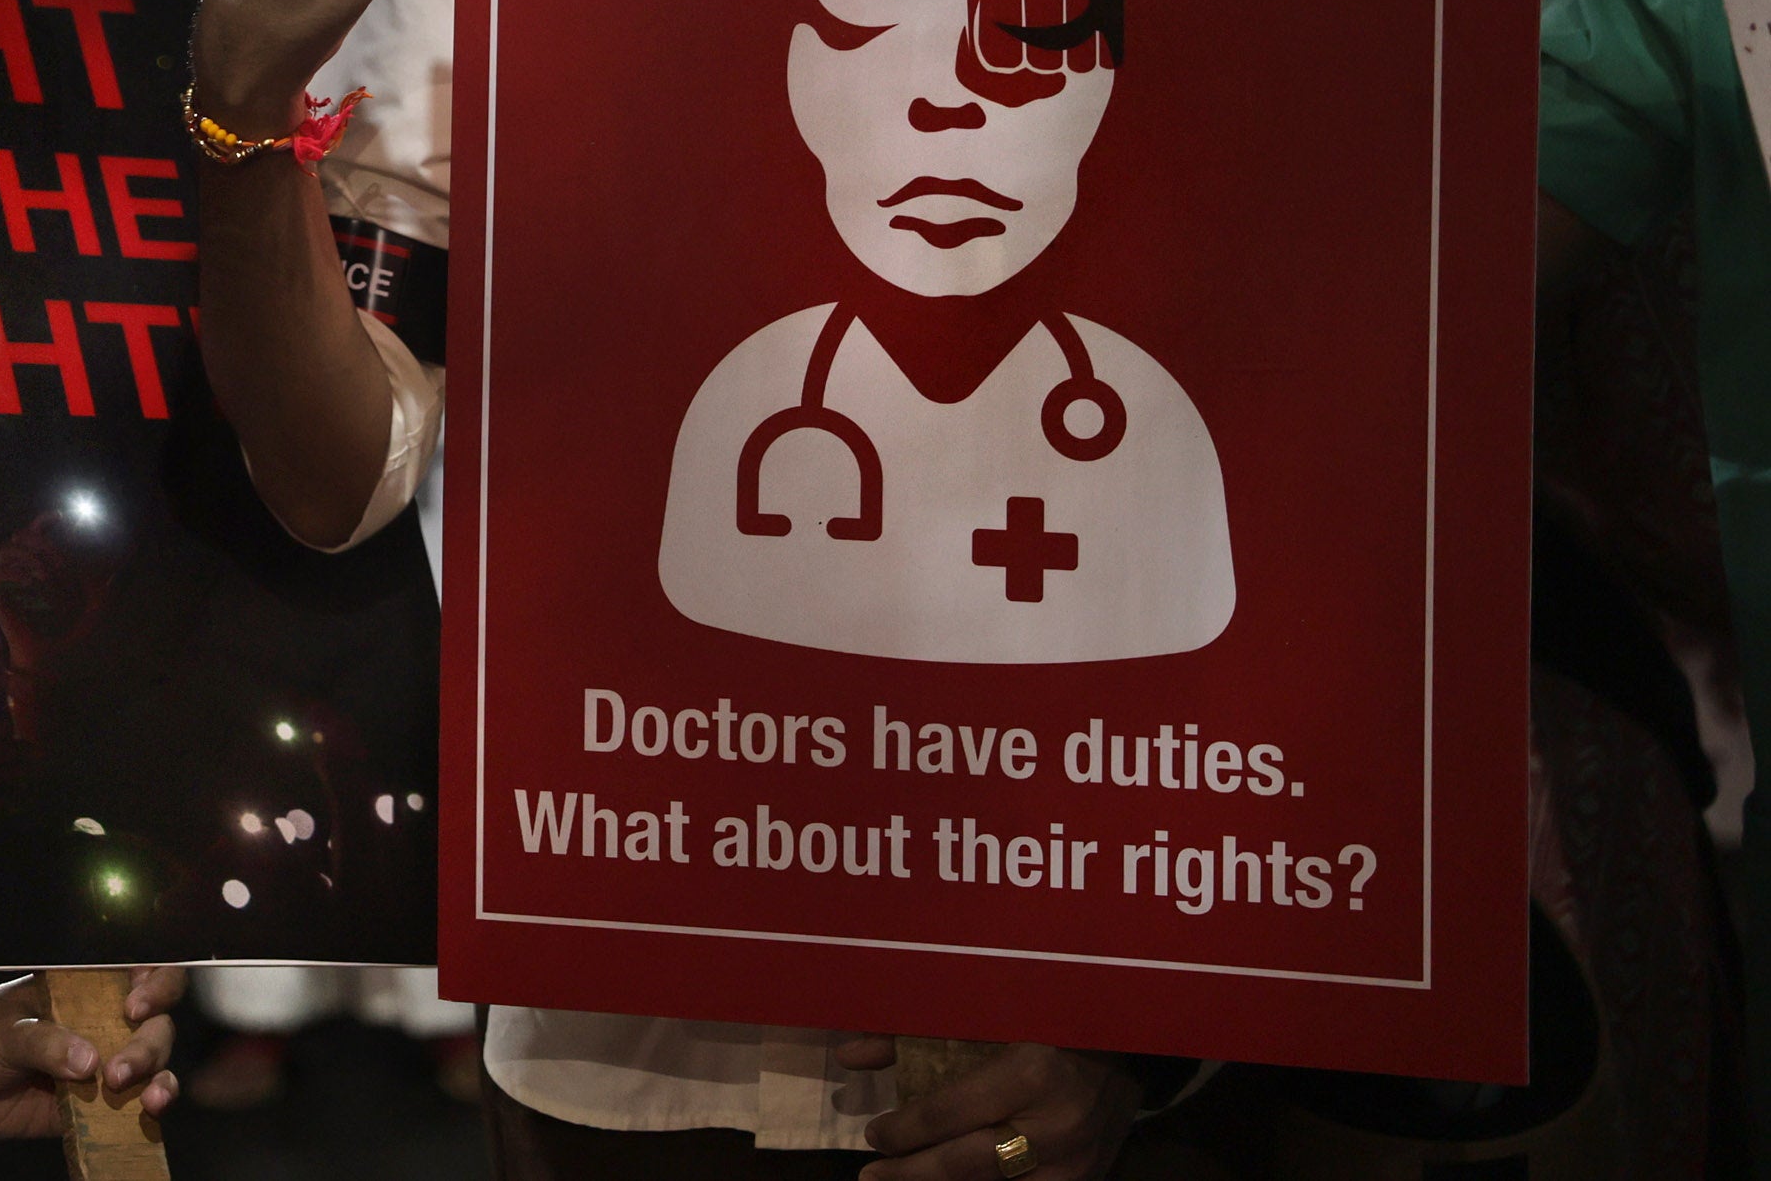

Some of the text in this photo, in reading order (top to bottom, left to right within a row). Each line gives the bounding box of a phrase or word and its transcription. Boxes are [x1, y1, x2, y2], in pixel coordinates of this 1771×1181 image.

[584, 688, 1304, 798] Doctors have duties.
[514, 788, 1378, 916] What about their rights?
